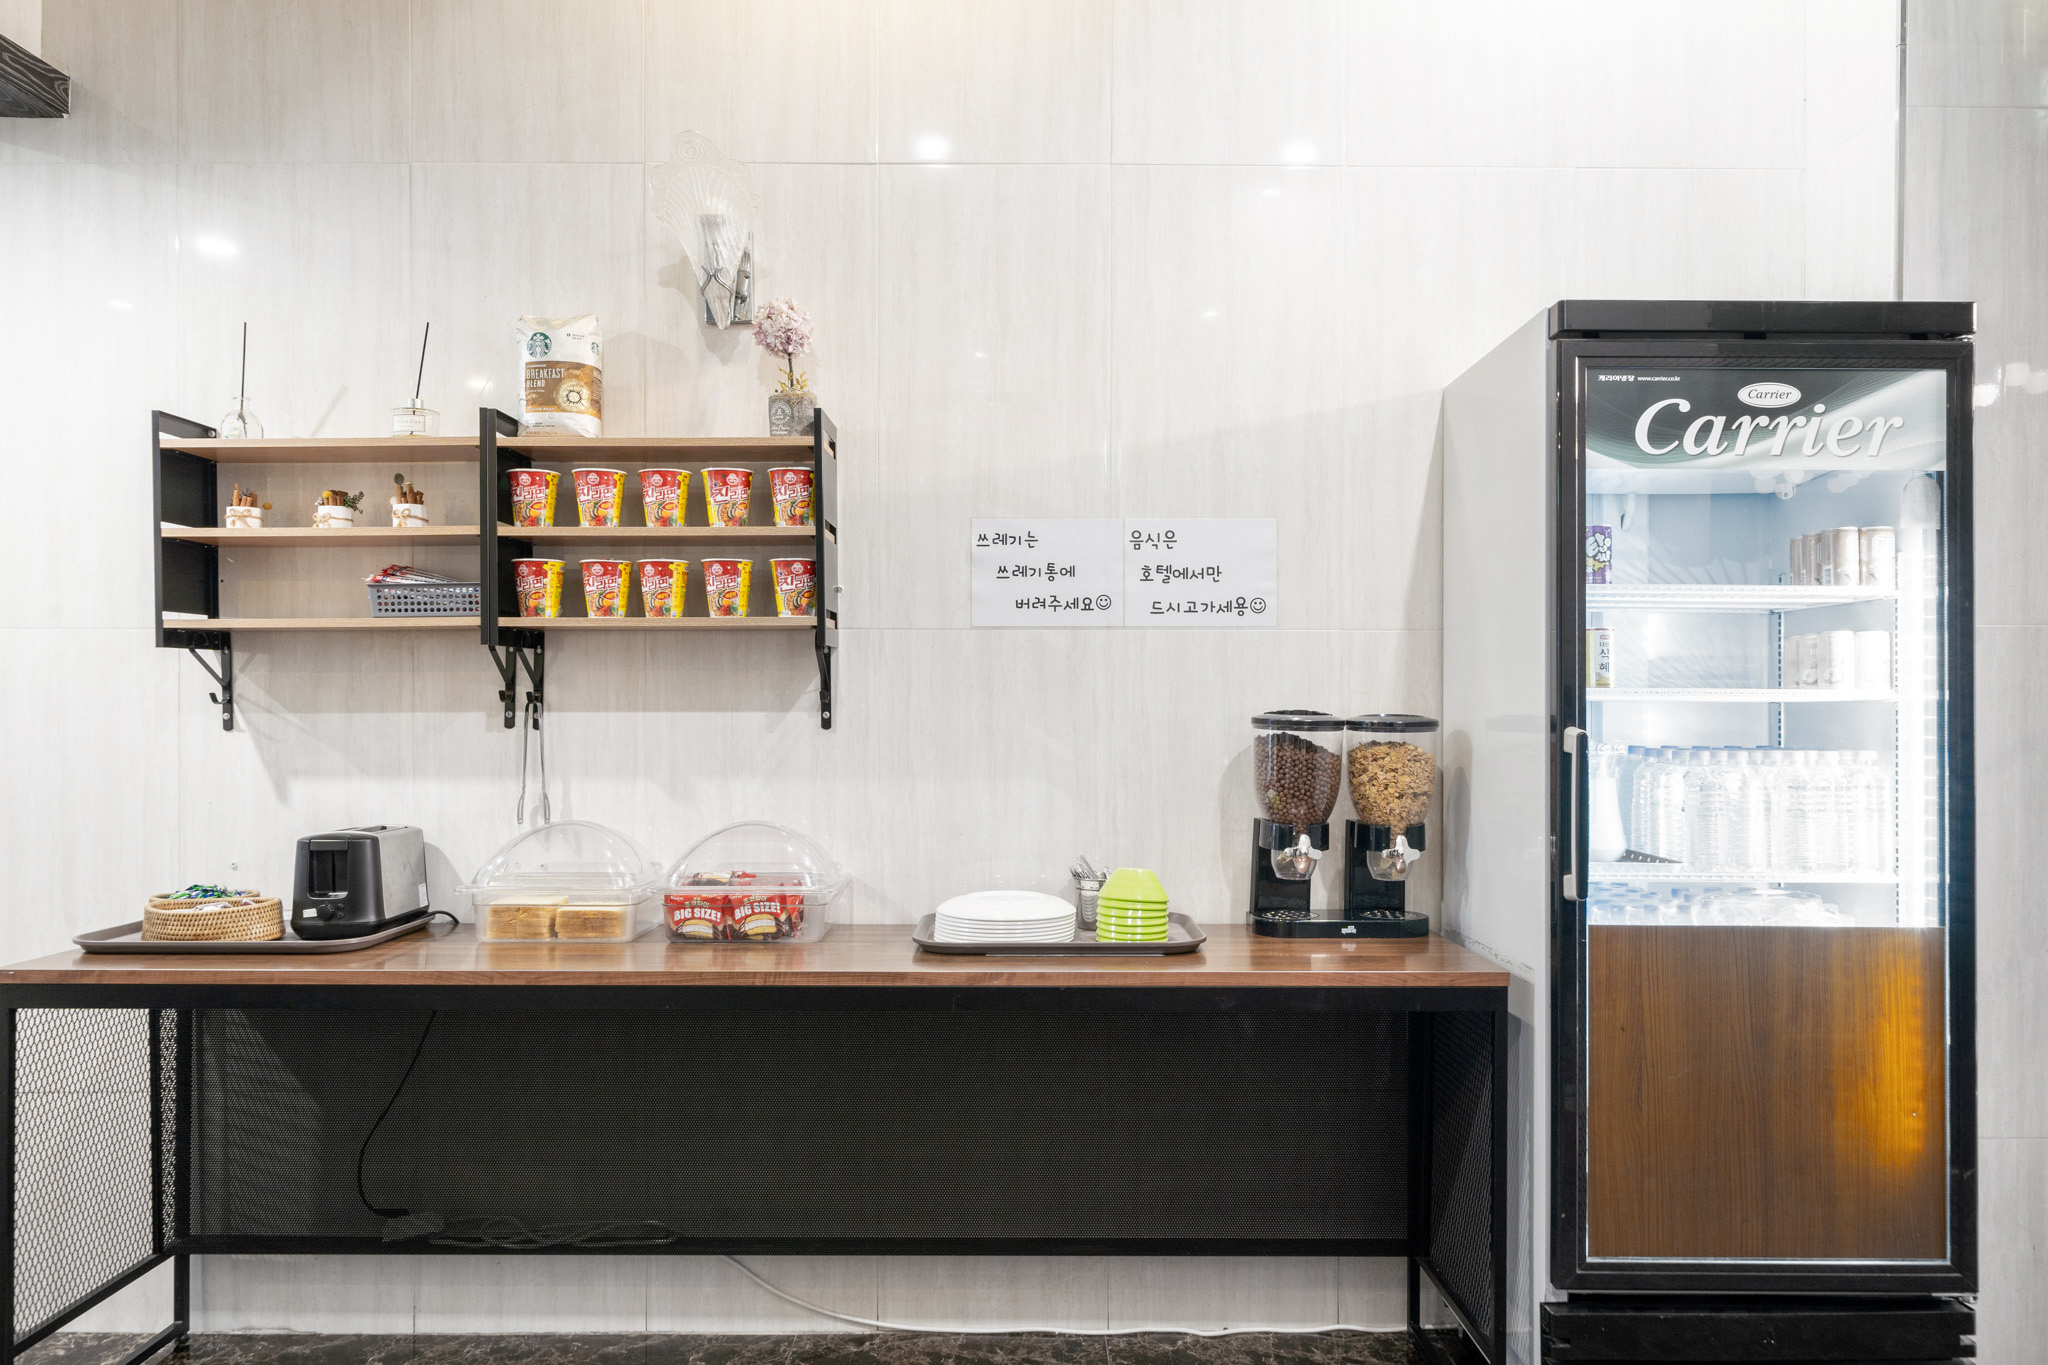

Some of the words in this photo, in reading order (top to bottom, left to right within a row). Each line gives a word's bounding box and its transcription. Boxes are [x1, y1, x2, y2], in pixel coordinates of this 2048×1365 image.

[526, 368, 565, 379] BREAKFAST
[1598, 374, 1635, 382] 캐리어냉장
[526, 379, 546, 388] BLEND
[1747, 388, 1793, 400] Carrier
[1634, 398, 1905, 457] Carrier
[976, 531, 1039, 549] 쓰레기는
[1129, 530, 1178, 550] 음식은
[996, 563, 1076, 582] 쓰레기통에
[1139, 564, 1222, 584] 호텔에서만
[1015, 595, 1096, 612] 버려주세요
[1150, 597, 1249, 617] 드시고가세용
[674, 908, 692, 921] BIG
[693, 907, 721, 922] SIZE!
[734, 904, 752, 920] BIG
[752, 902, 781, 914] SIZE!
